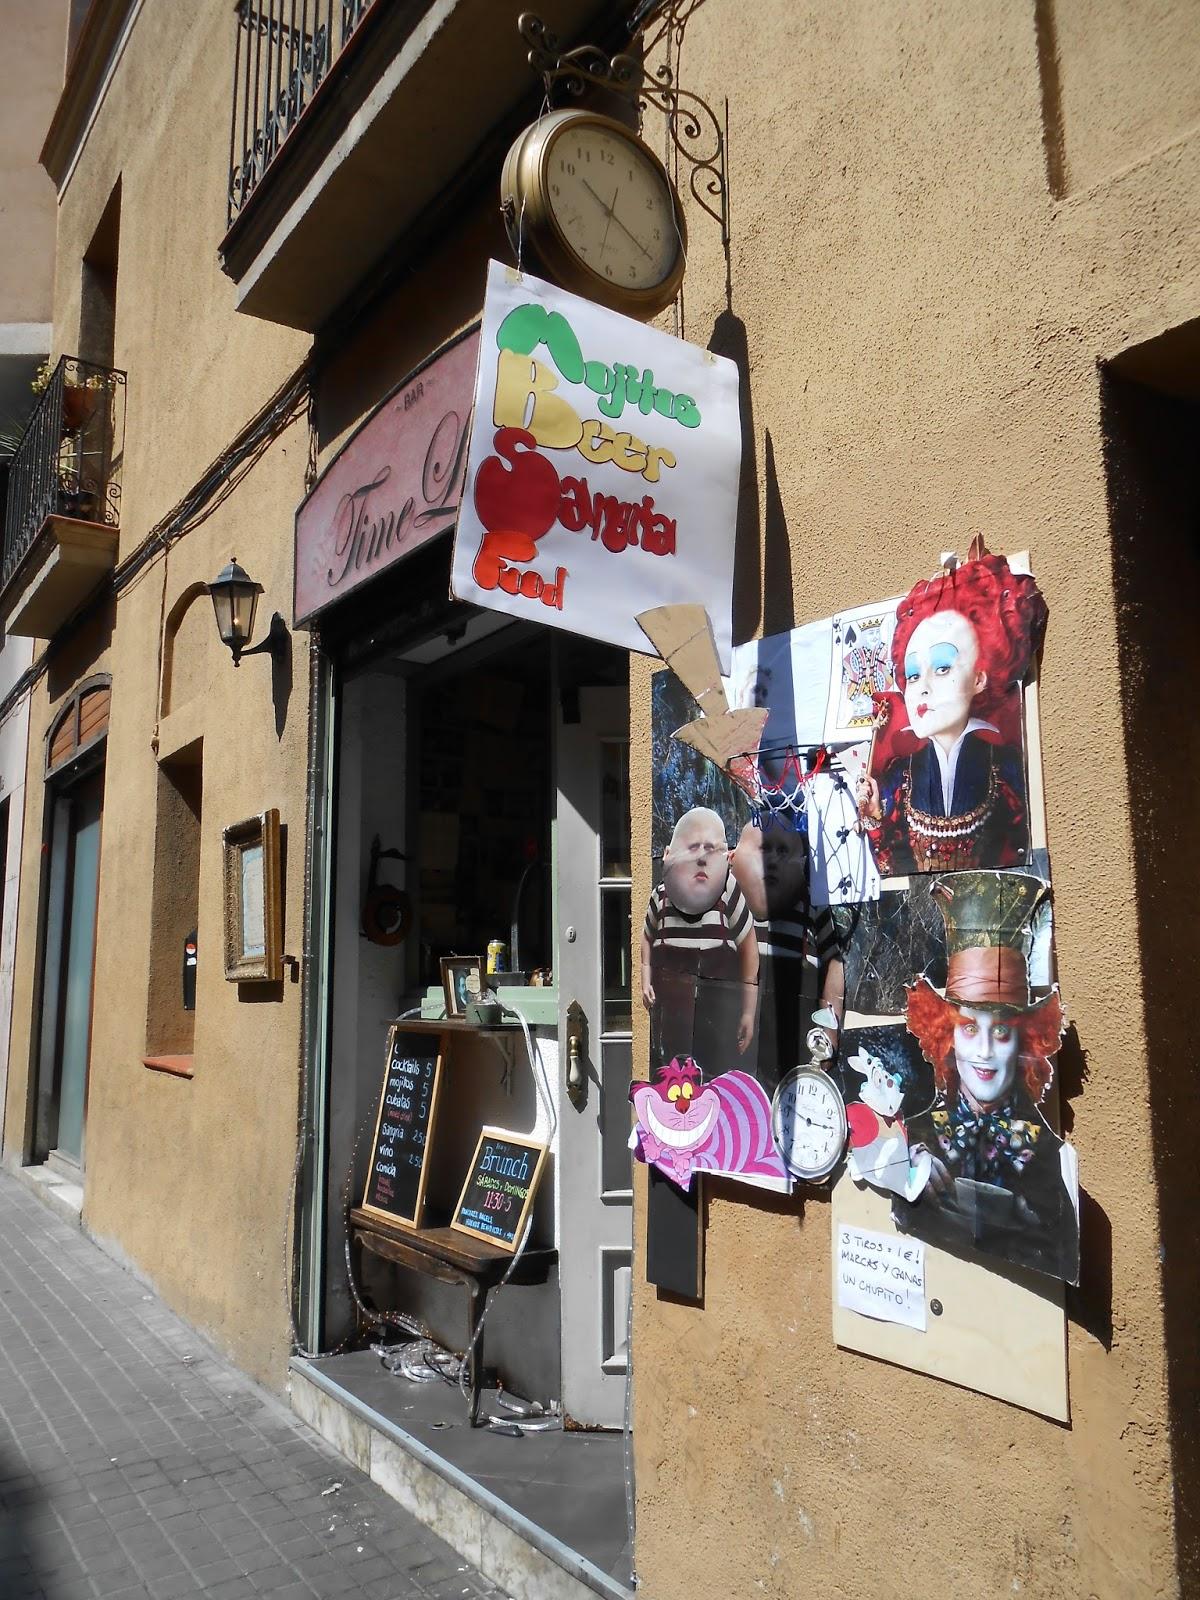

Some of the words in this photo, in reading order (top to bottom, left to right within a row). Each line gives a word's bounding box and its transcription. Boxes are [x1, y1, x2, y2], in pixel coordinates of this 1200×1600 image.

[560, 159, 575, 176] 10
[600, 150, 615, 166] 12
[403, 382, 425, 411] BAR
[493, 348, 677, 483] Beer
[327, 465, 416, 587] Time
[472, 532, 568, 610] Food
[424, 1062, 432, 1078] 5
[421, 1082, 430, 1097] 5
[418, 1101, 428, 1119] 5
[479, 1145, 528, 1180] Brunch
[842, 1232, 851, 1245] 3
[854, 1236, 883, 1252] TIROS
[841, 1249, 879, 1270] MARCAS
[842, 1272, 856, 1286] UN
